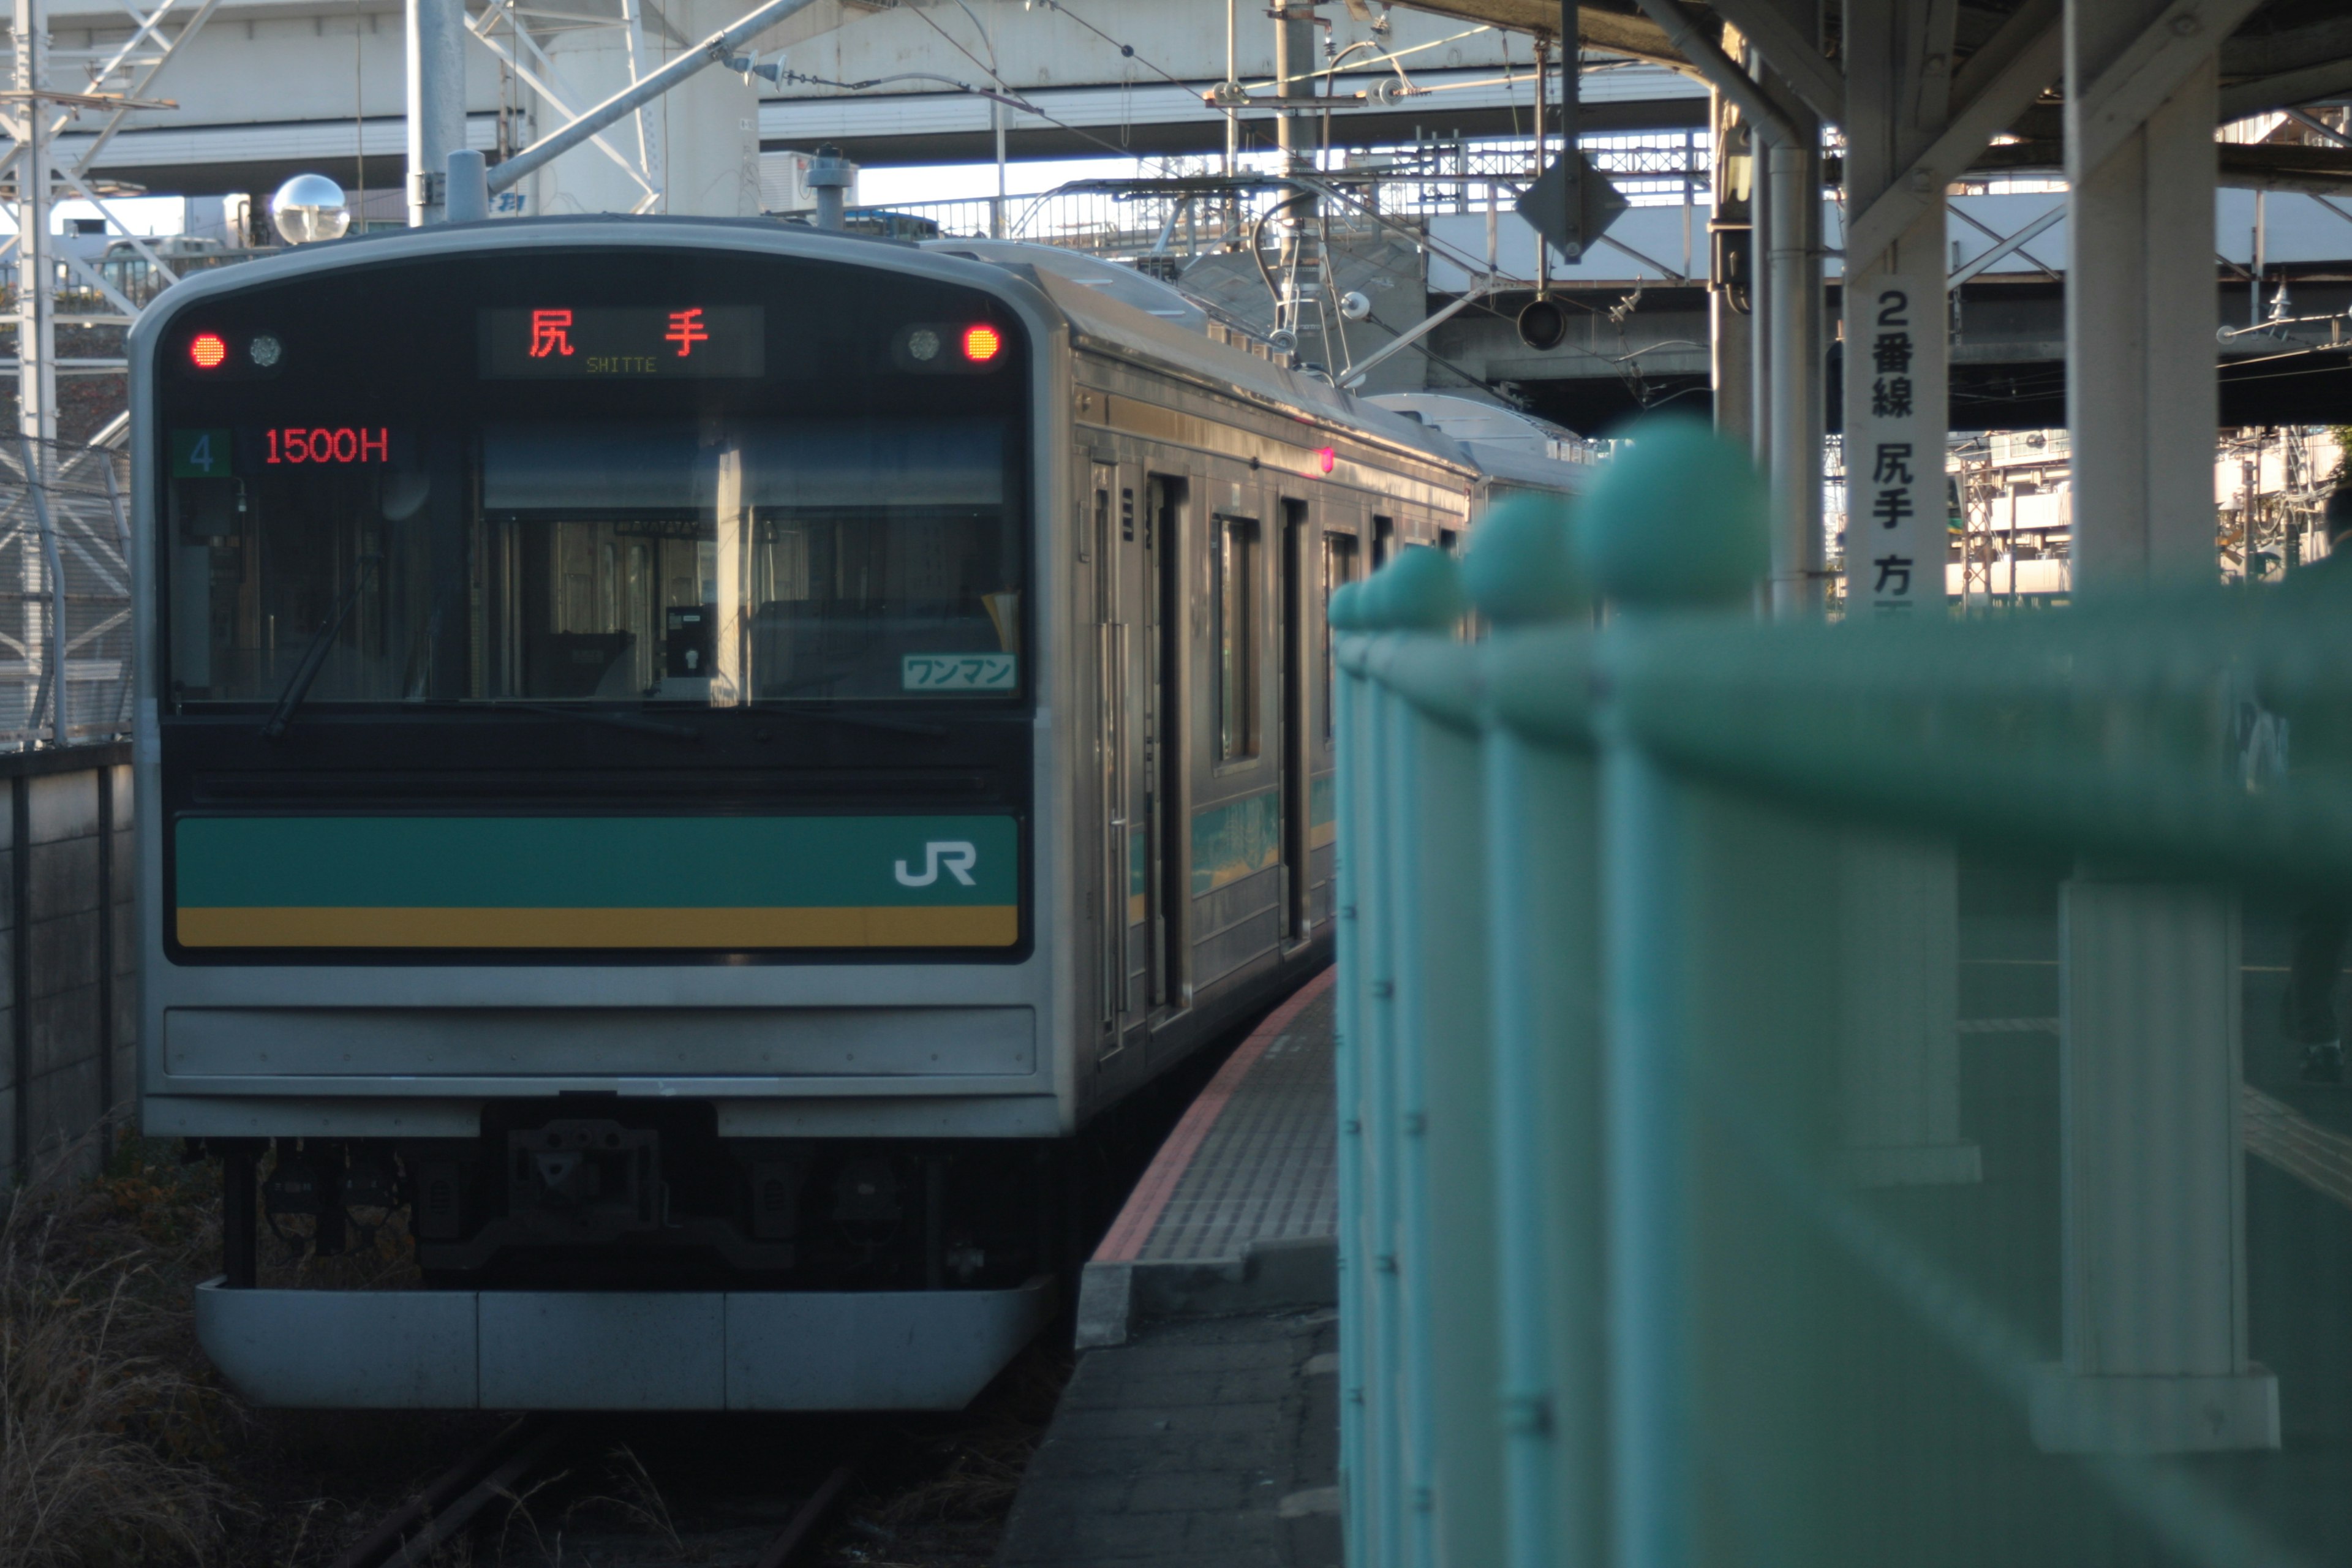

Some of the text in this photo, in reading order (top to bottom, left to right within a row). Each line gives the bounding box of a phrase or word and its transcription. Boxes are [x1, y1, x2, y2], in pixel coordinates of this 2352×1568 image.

[529, 309, 709, 357] 尻手
[587, 357, 657, 372] SHITTE
[1872, 290, 1913, 419] 2番線
[190, 434, 213, 472] 4
[266, 428, 388, 463] 1500H
[1872, 443, 1913, 529] 尻手
[908, 660, 1011, 685] ワンマン
[895, 842, 976, 887] JR
